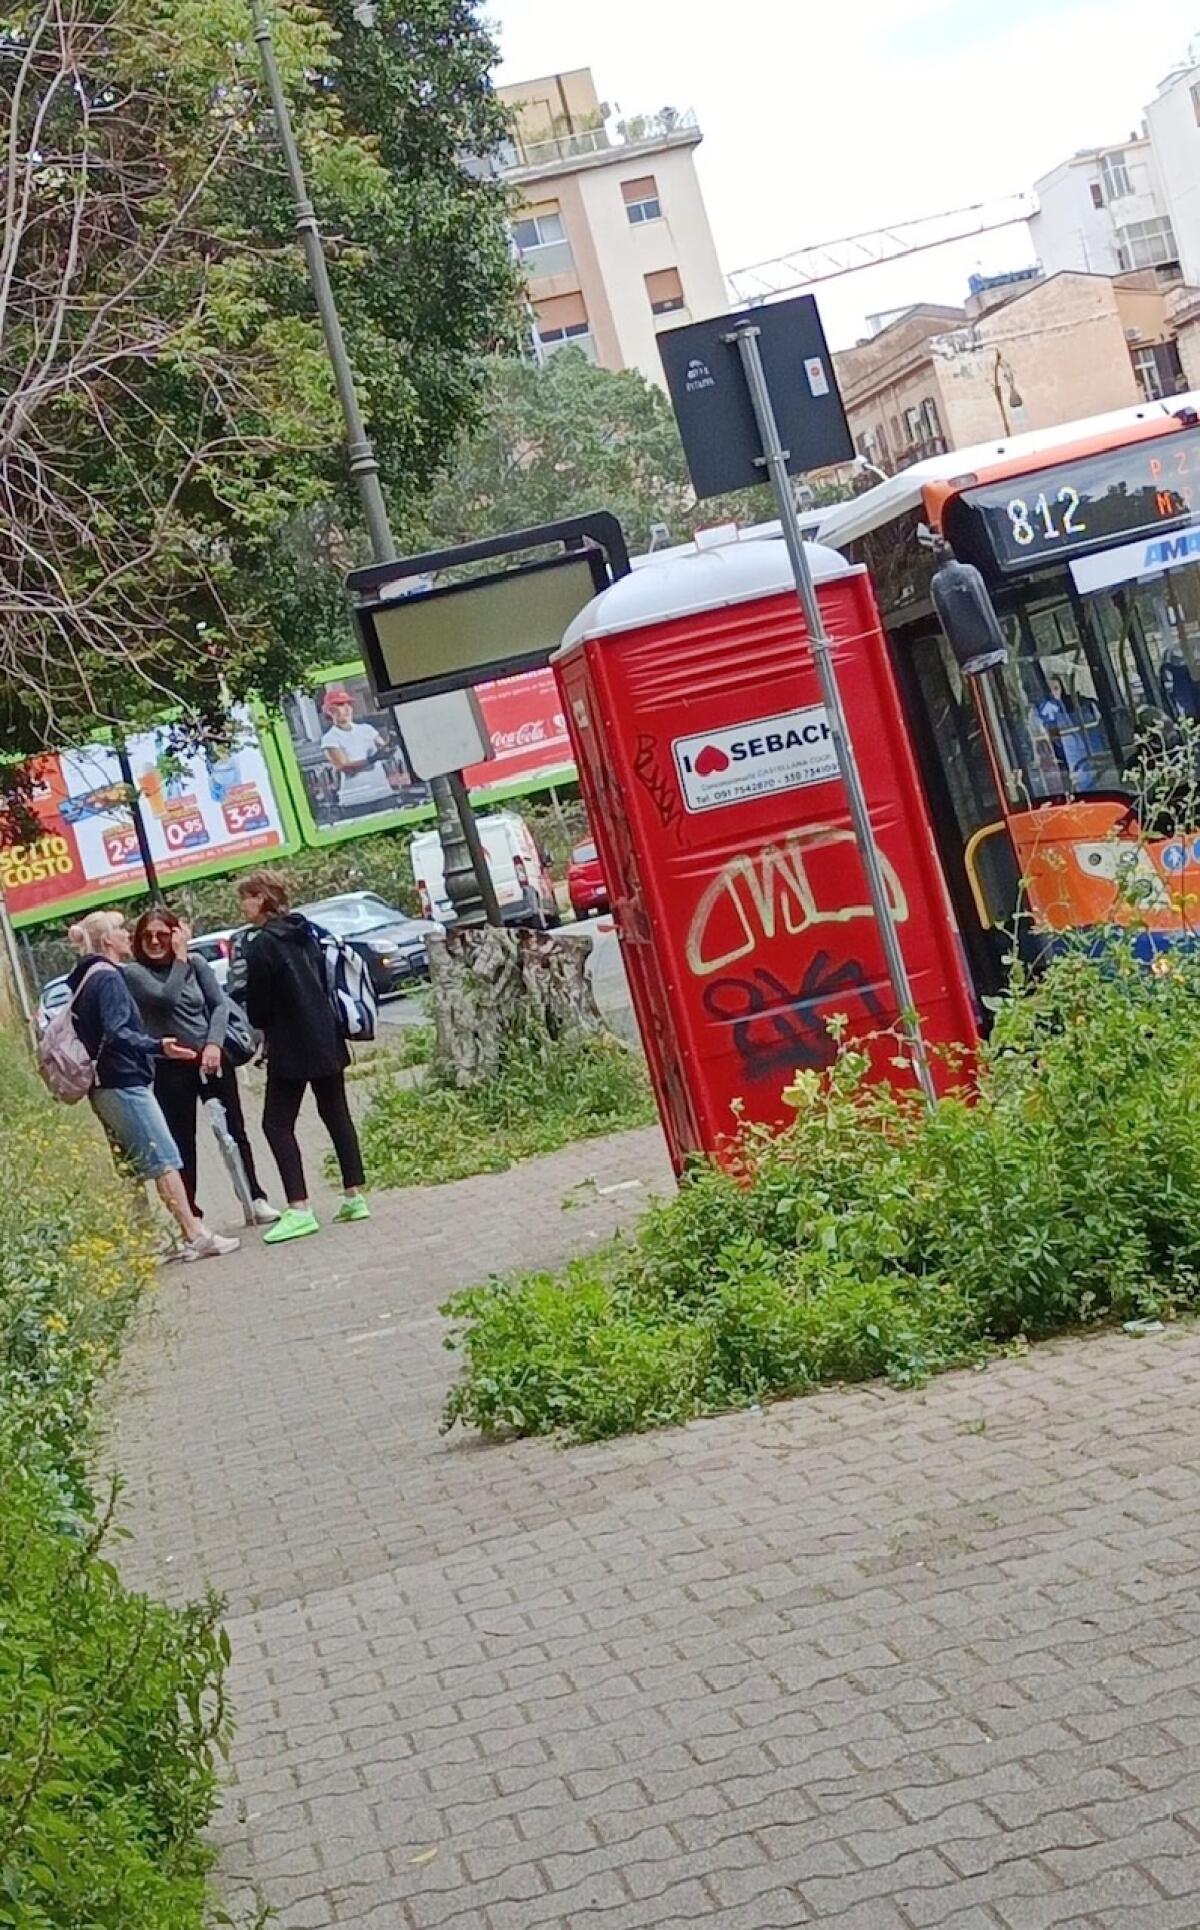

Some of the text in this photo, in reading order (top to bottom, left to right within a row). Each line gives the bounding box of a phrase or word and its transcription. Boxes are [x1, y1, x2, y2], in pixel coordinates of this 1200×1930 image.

[1007, 486, 1086, 545] 812
[683, 755, 692, 773] I
[4, 855, 74, 888] COSTO
